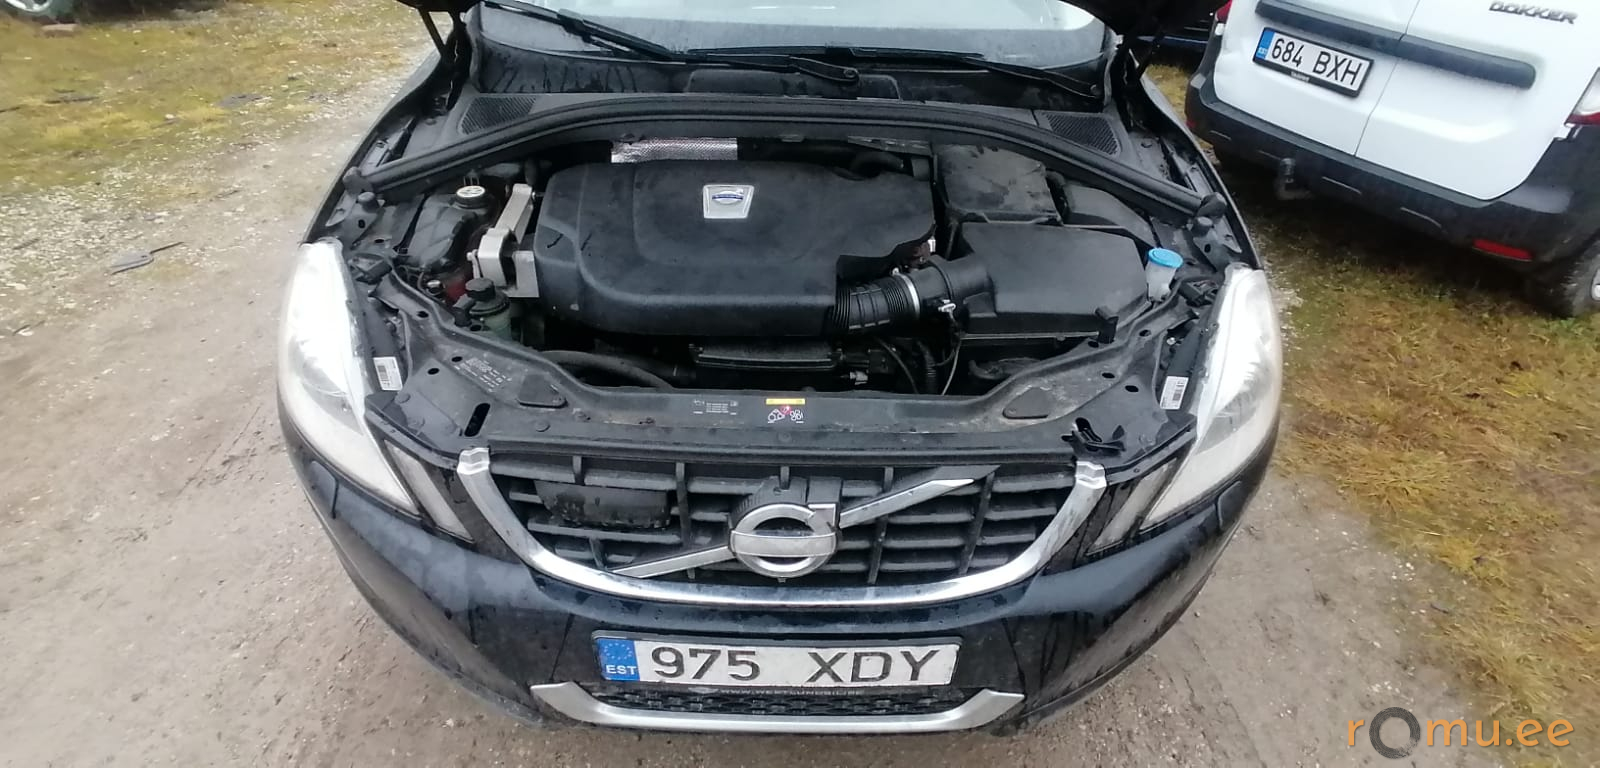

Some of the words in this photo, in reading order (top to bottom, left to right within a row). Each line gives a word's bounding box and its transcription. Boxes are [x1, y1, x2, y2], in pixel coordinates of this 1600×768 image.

[1489, 2, 1578, 24] DOKKER
[1271, 38, 1304, 68] 684
[1312, 50, 1362, 86] BXH
[605, 664, 637, 675] EST
[651, 646, 761, 682] 975
[807, 650, 942, 684] XDY
